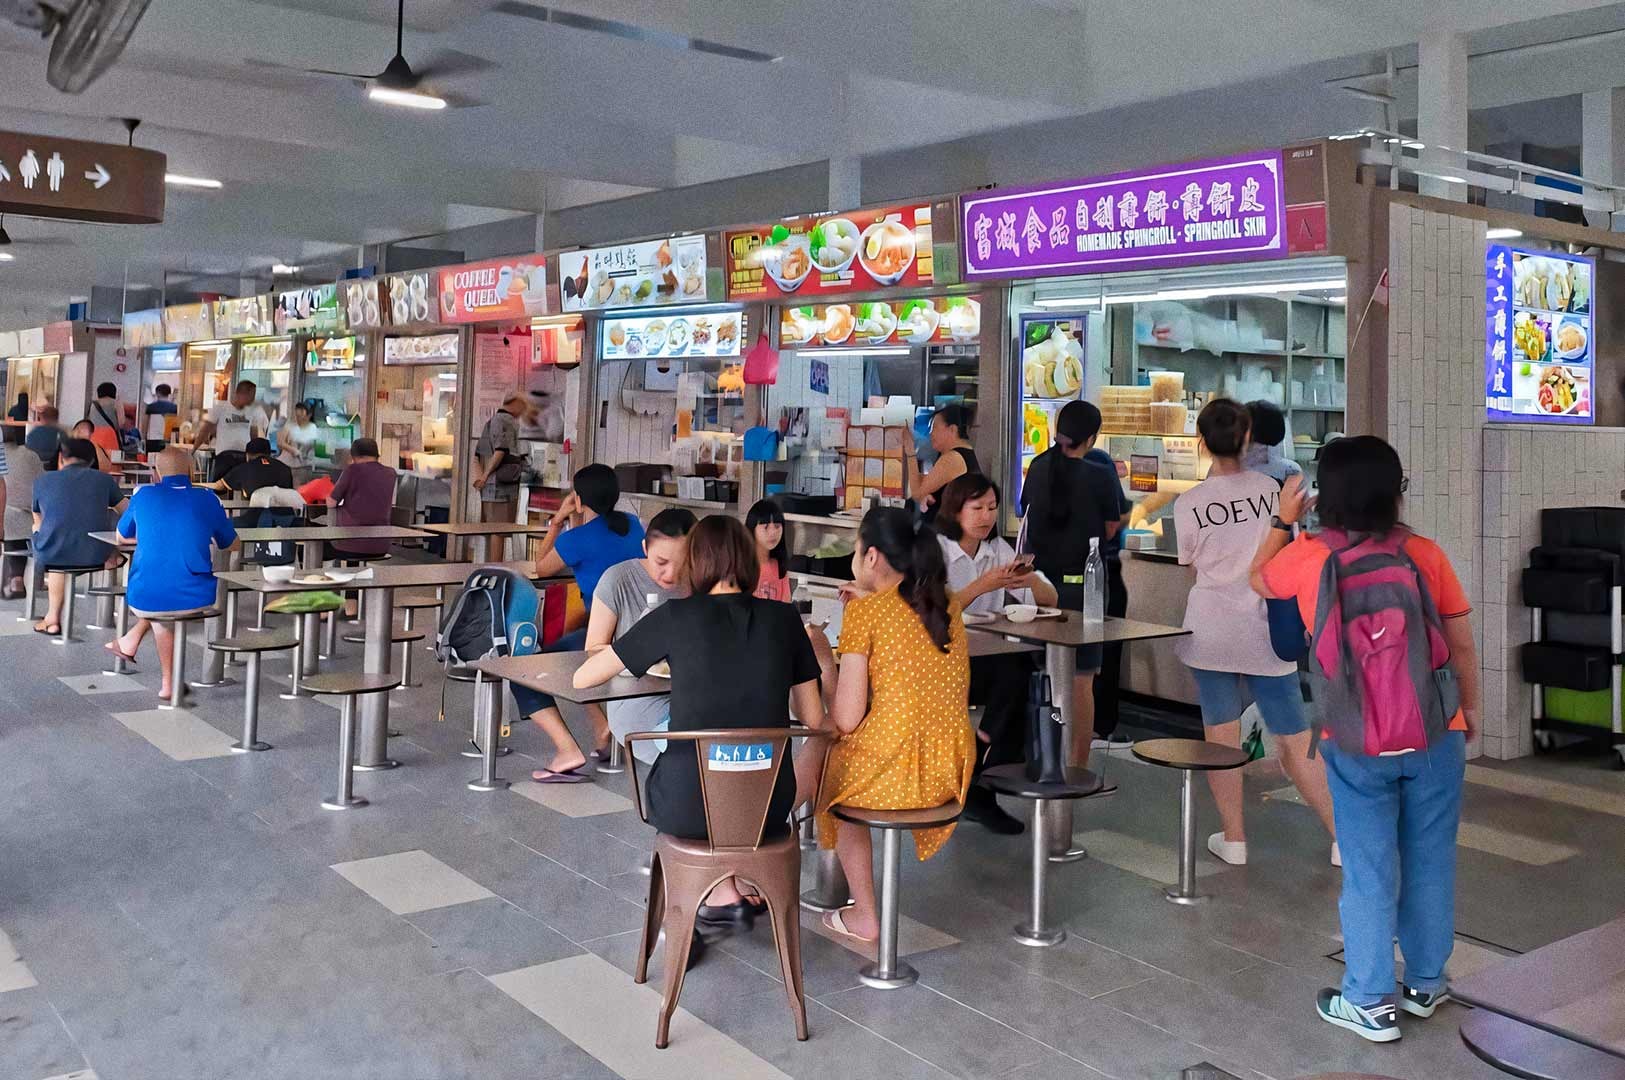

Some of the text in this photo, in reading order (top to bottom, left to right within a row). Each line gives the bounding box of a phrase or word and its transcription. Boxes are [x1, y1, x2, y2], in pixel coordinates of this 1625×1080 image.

[1077, 216, 1266, 252] HOMEMADE SPRINGROLL SPRINGROLL SKIN
[455, 268, 496, 289] COFFEE
[1192, 491, 1281, 529] LOEW
